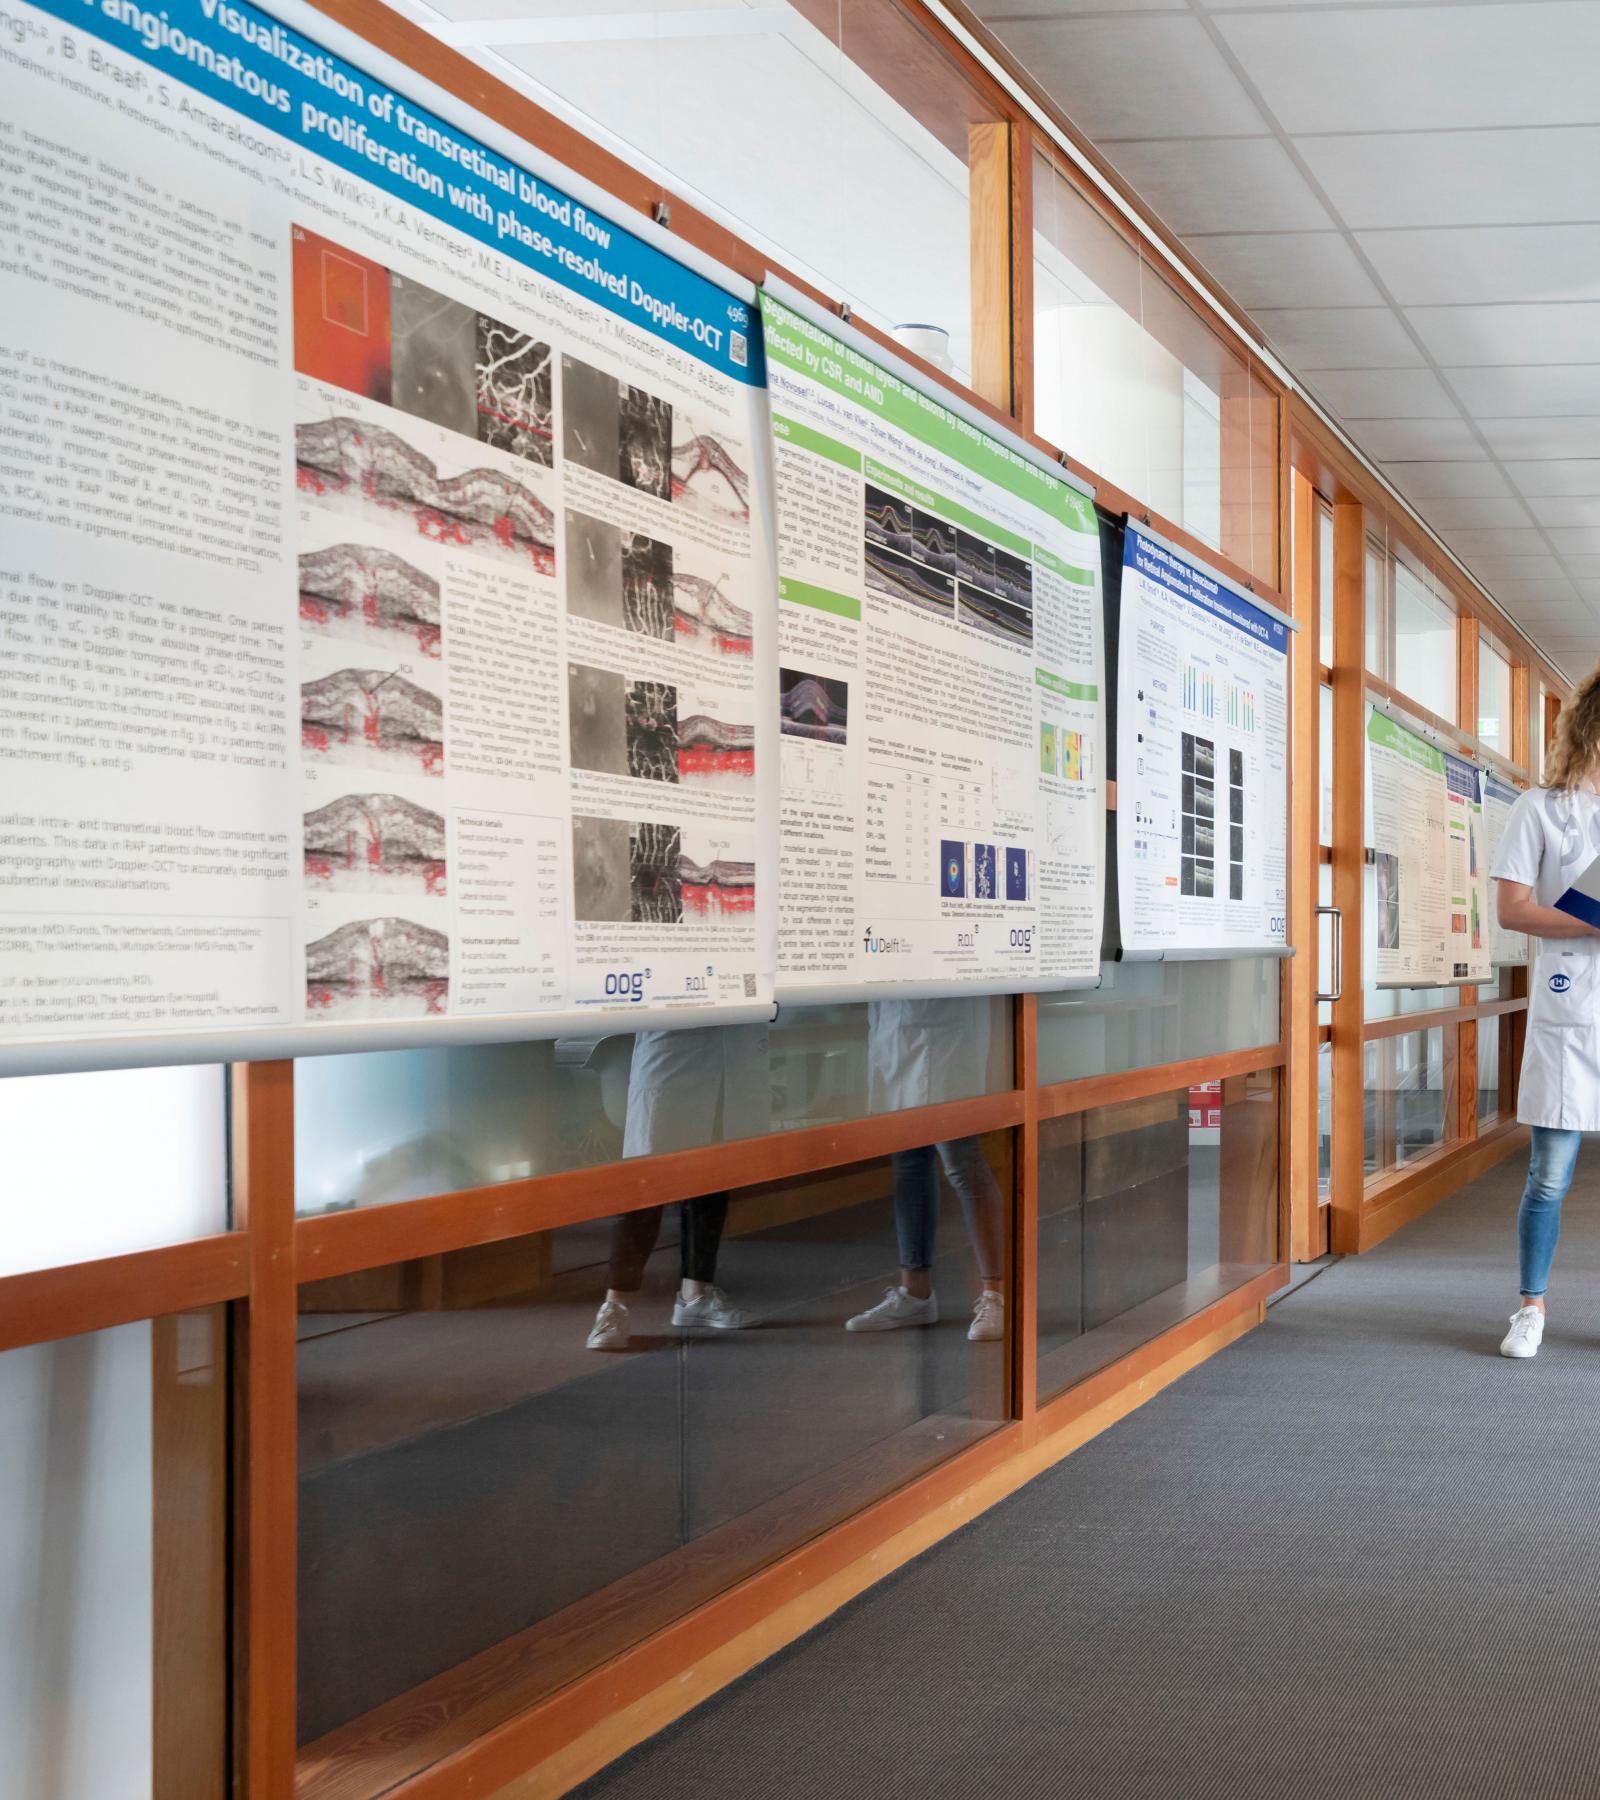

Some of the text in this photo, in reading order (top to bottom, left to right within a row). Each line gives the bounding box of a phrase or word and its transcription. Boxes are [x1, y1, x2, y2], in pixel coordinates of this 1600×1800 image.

[101, 0, 723, 352] angiomatous proliferation with phase-resolved Doppler-OCT
[200, 0, 611, 250] Visualization of transretinal blood flow
[766, 324, 804, 361] ffected
[805, 346, 820, 373] by
[821, 355, 843, 383] CSR
[844, 373, 863, 394] and
